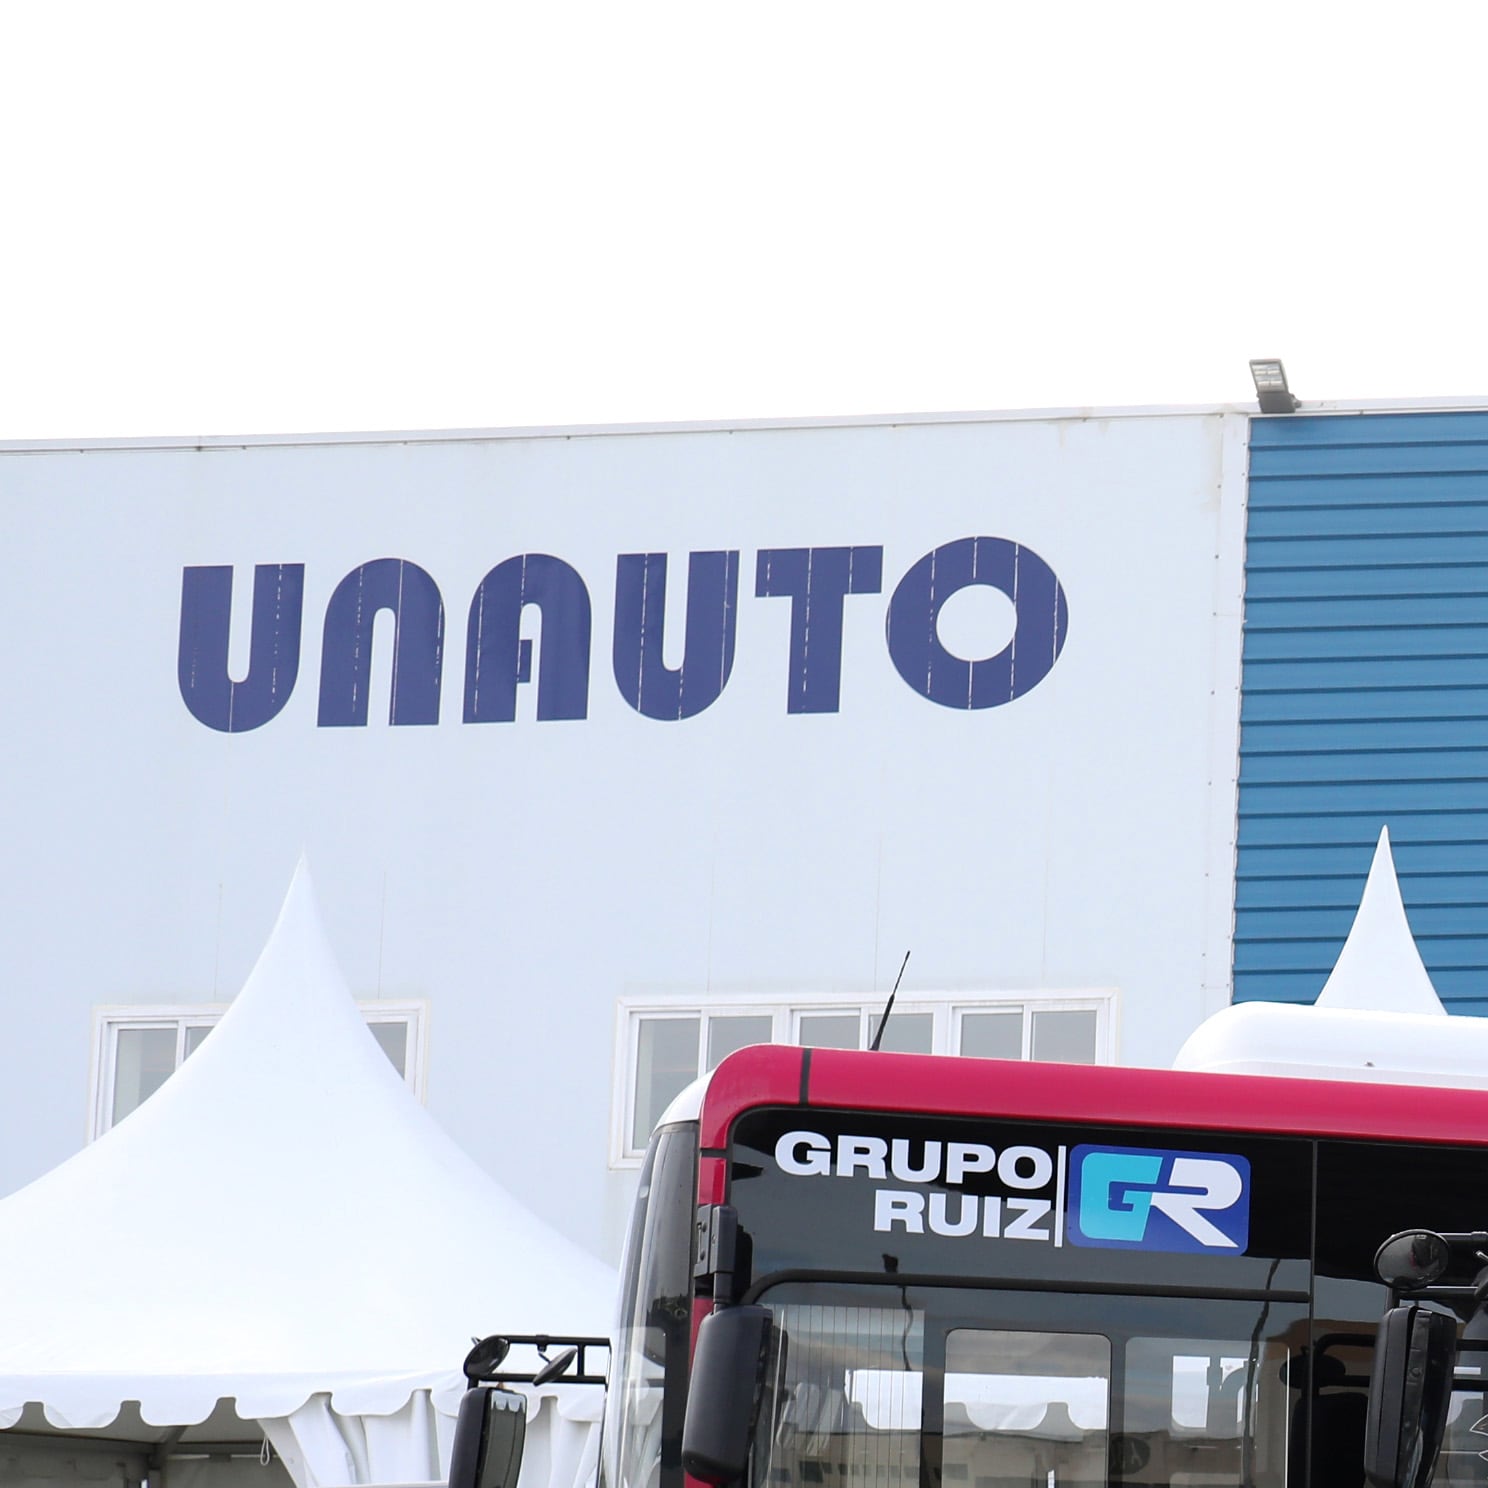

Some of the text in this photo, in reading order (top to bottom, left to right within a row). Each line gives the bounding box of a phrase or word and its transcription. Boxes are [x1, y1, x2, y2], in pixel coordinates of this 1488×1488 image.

[178, 536, 1068, 733] UNAUTO
[774, 1131, 1053, 1190] GRUPO
[873, 1190, 1052, 1242] RUIZ
